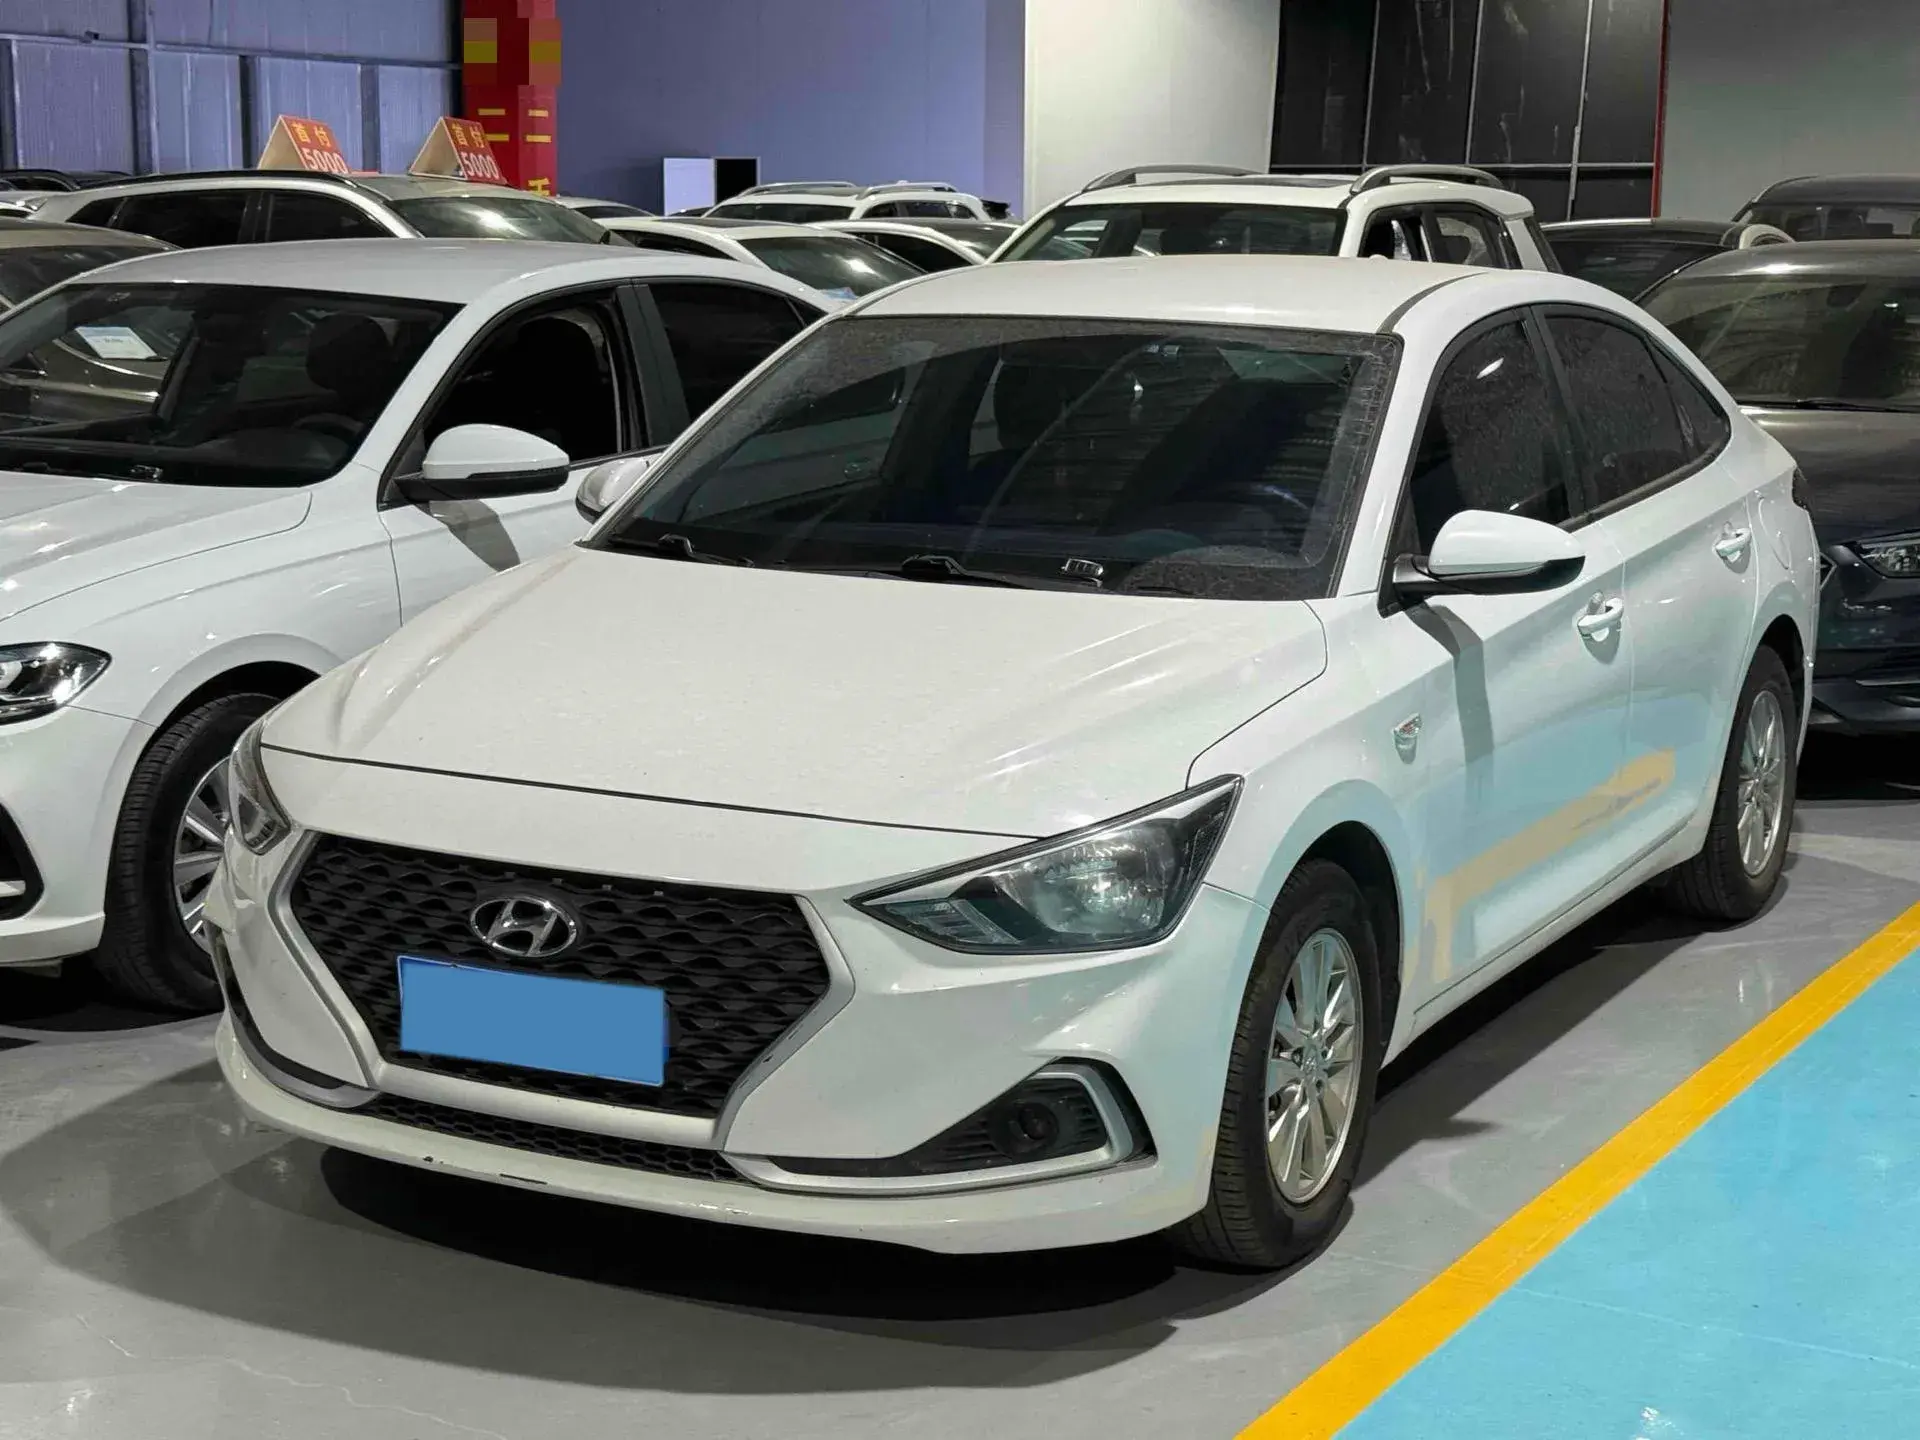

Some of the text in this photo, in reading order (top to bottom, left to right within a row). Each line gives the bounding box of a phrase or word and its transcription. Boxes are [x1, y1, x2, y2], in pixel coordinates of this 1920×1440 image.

[291, 121, 331, 148] 首付
[451, 122, 485, 148] 首付
[301, 148, 349, 174] 5000
[461, 152, 500, 179] 5000
